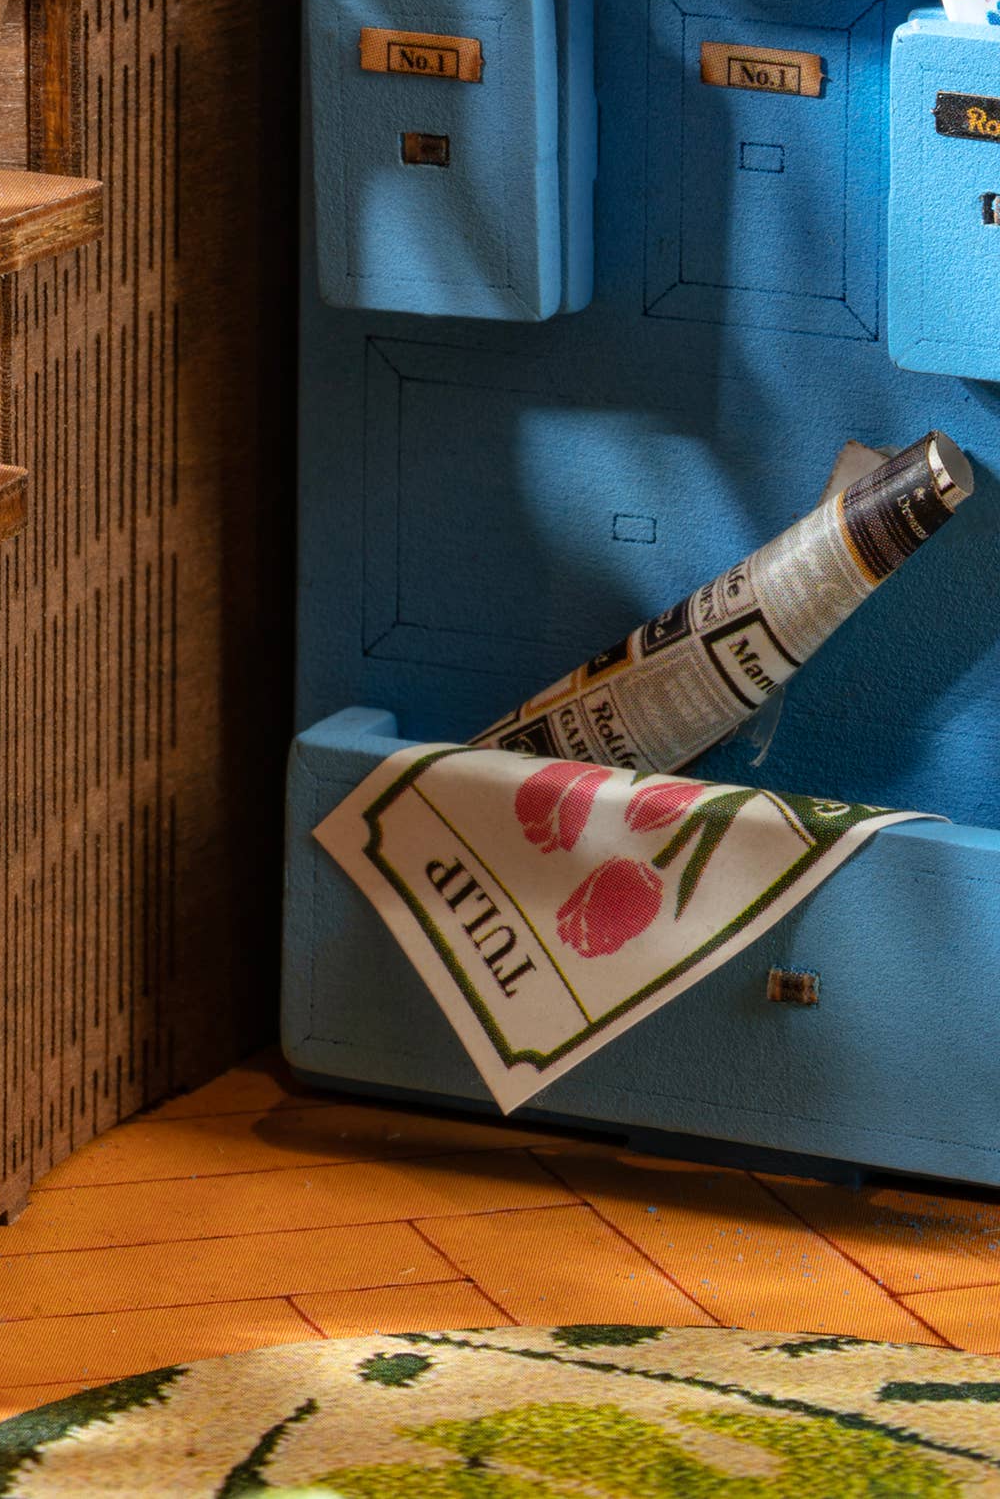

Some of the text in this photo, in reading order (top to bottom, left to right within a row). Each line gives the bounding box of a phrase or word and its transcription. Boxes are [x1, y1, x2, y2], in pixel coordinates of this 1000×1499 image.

[399, 47, 445, 72] No.1
[741, 64, 787, 88] No.1
[425, 856, 537, 999] TULIP
